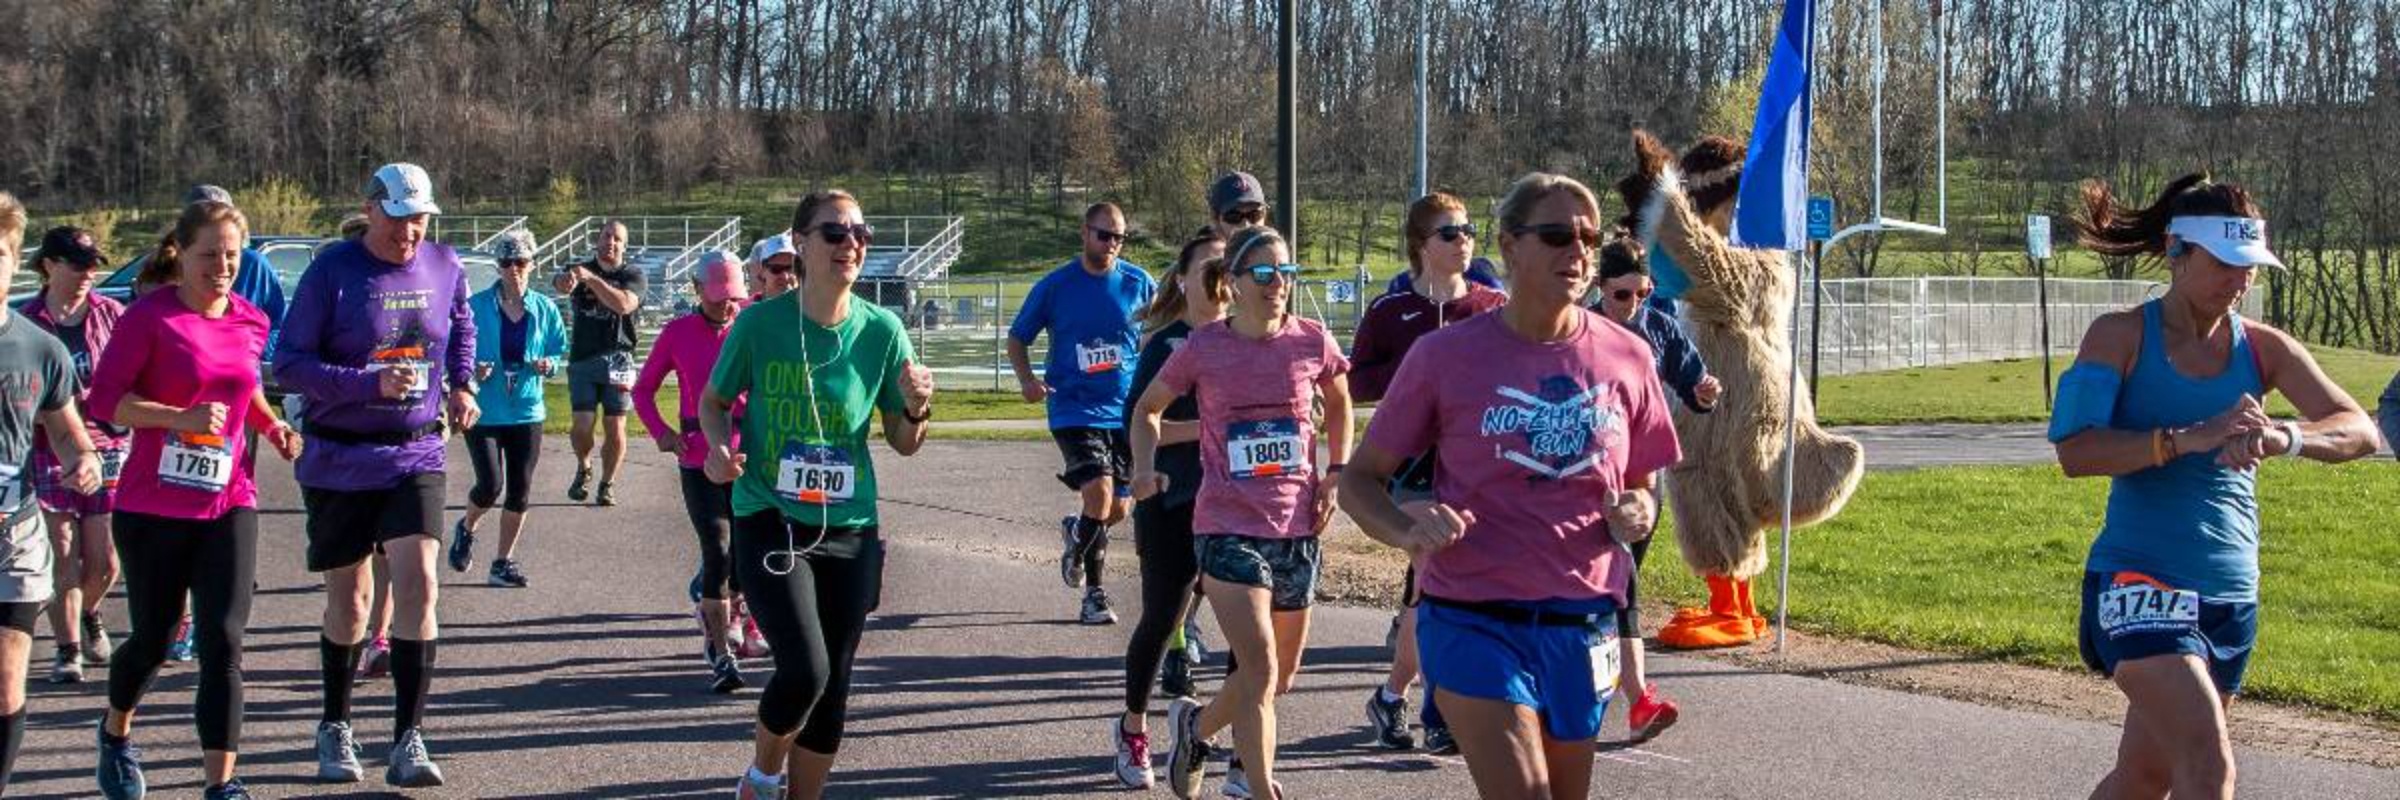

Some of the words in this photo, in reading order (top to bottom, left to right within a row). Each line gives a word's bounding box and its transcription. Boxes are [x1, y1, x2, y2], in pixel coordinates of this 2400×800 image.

[1243, 442, 1291, 465] 1803
[1532, 430, 1586, 456] RUN
[175, 453, 220, 478] 1761
[2116, 590, 2181, 617] 1747
